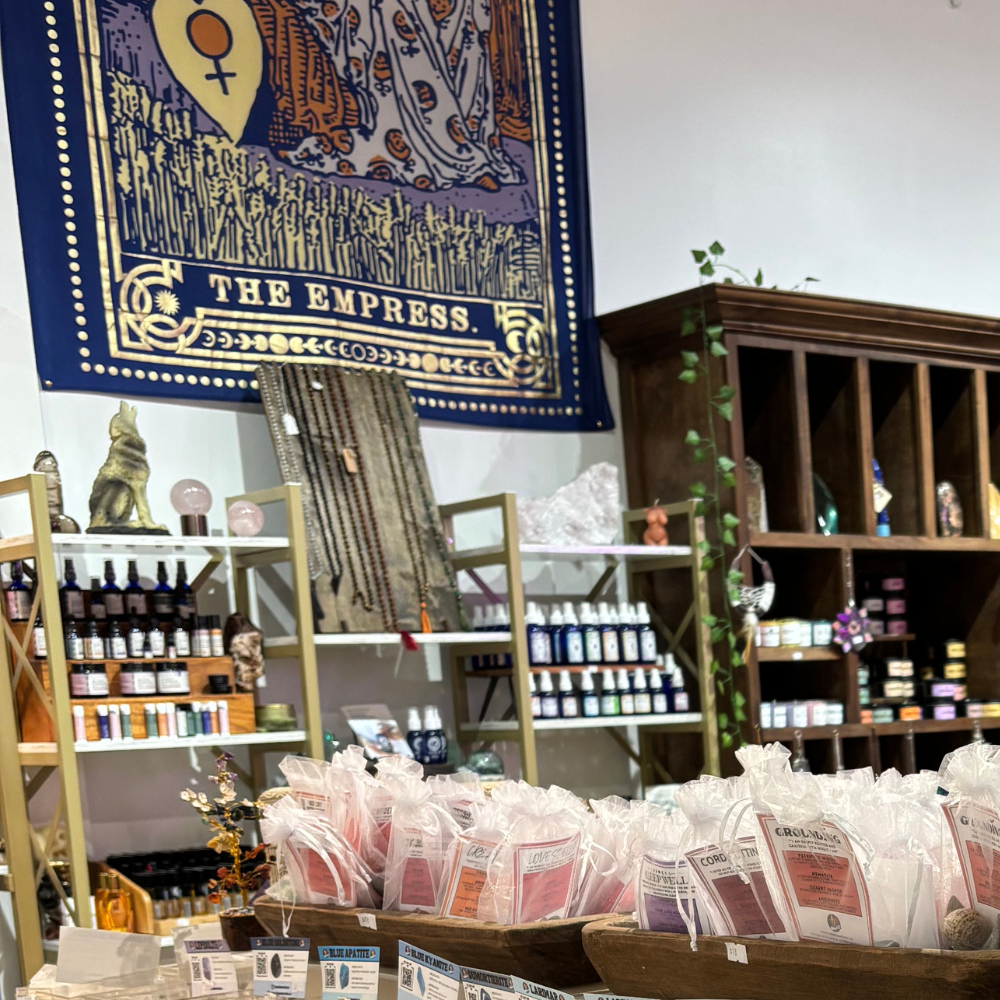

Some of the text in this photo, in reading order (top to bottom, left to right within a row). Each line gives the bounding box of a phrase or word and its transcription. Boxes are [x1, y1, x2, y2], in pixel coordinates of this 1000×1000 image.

[208, 273, 479, 333] THE EMPRESS.
[329, 948, 370, 959] BLUE APATITE
[411, 949, 424, 961] BLUE
